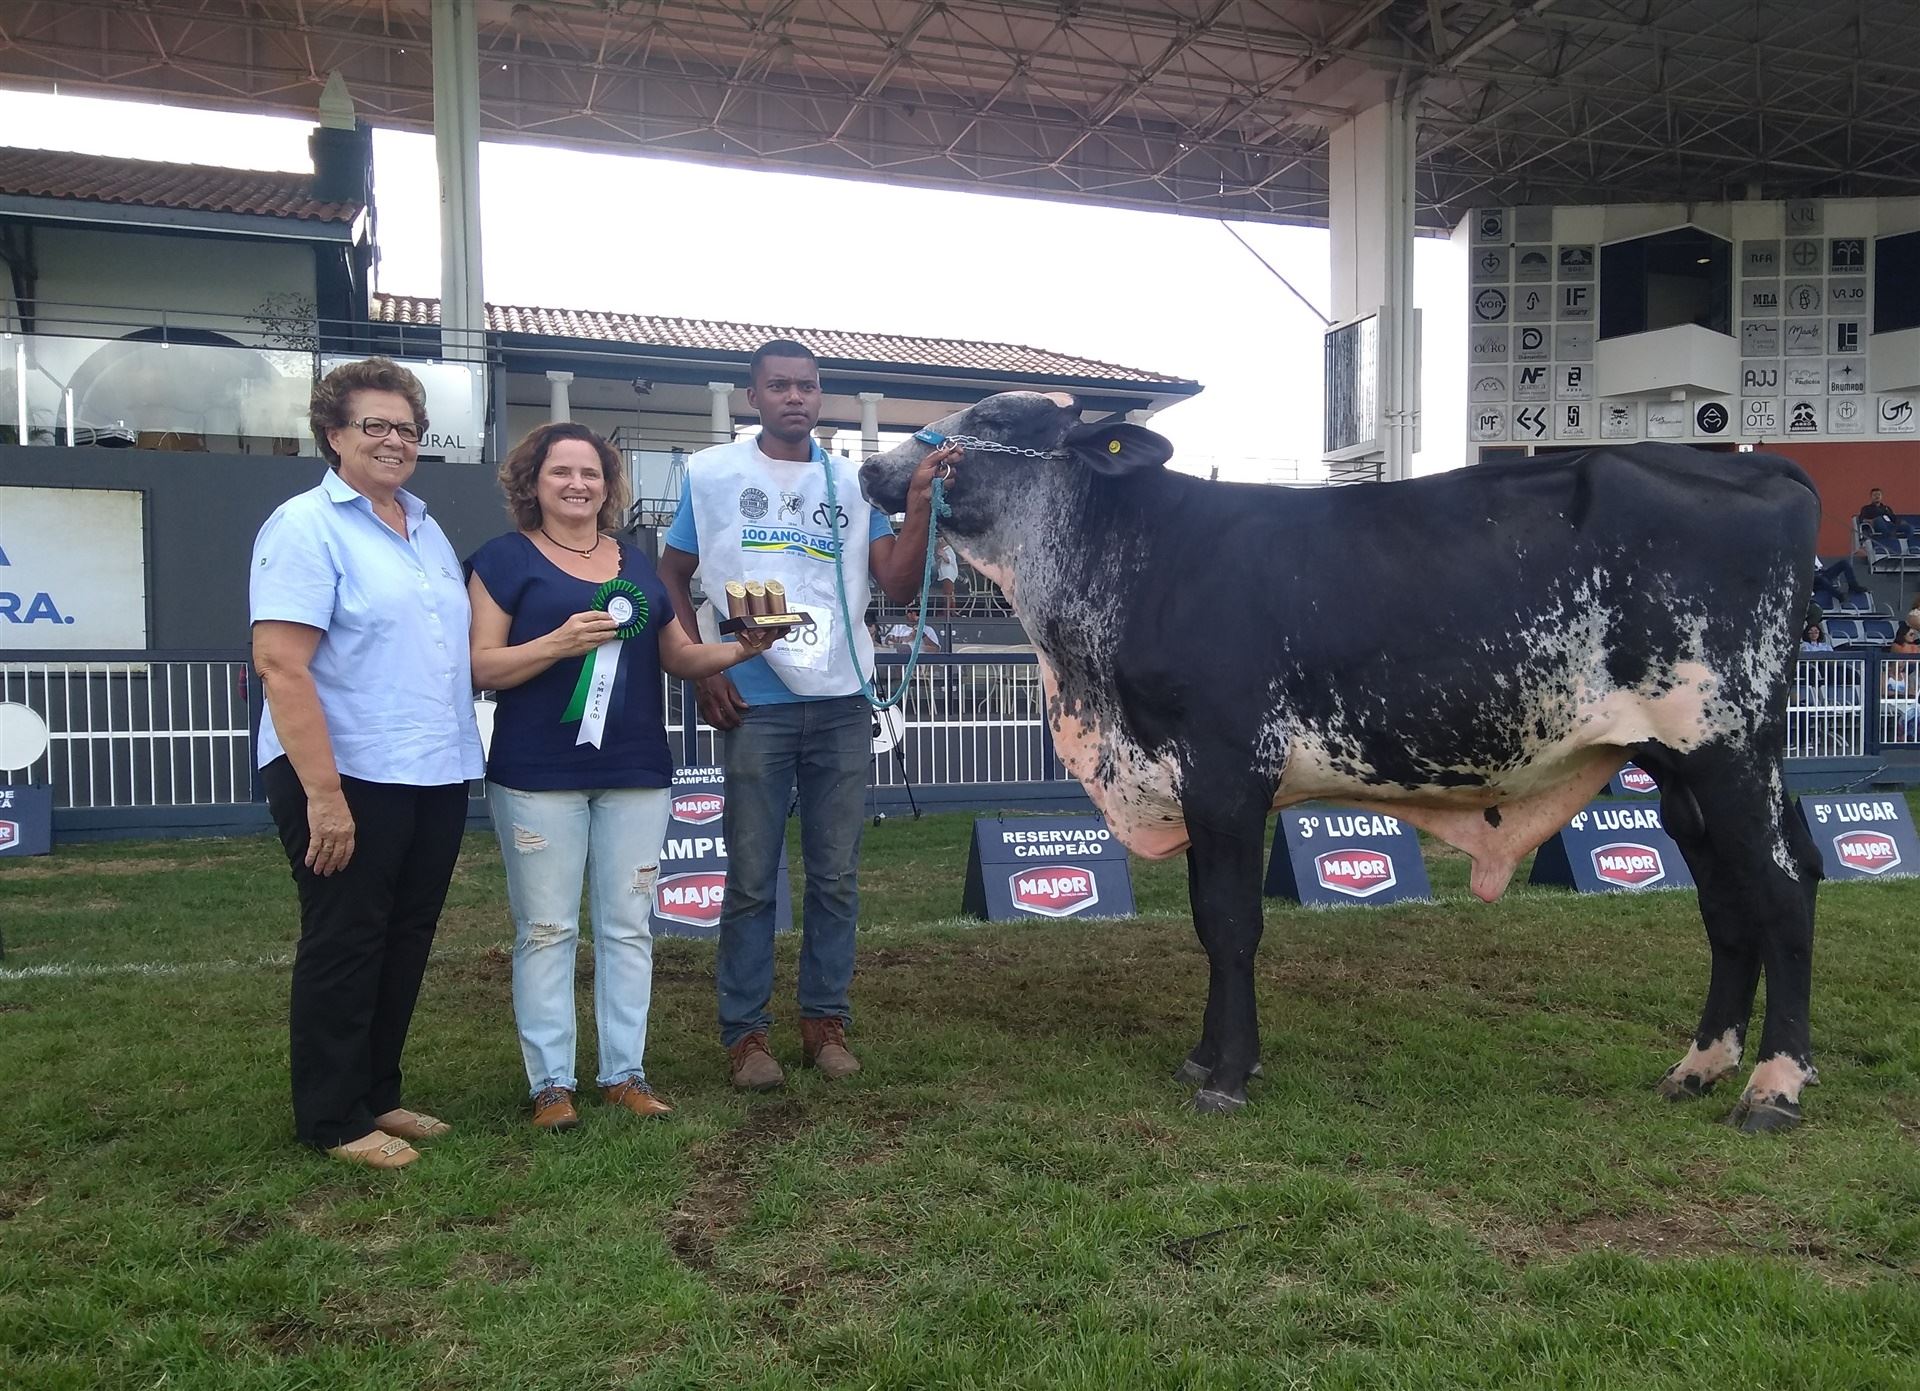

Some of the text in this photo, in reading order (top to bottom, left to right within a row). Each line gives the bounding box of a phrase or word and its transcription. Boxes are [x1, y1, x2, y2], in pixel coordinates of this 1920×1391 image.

[1566, 288, 1587, 306] IF
[1753, 294, 1777, 305] MRA
[1520, 367, 1546, 384] NF
[1745, 370, 1777, 387] AJJ
[1751, 401, 1771, 413] OT
[1746, 415, 1775, 426] OT5
[742, 528, 767, 540] 100
[769, 530, 809, 545] ANOS
[672, 775, 725, 785] CAMPEÃO
[676, 767, 722, 777] GRANDE
[675, 800, 721, 814] MAJOR
[1814, 801, 1898, 823] 5º LUGAR
[1298, 815, 1402, 838] 3º LUGAR
[1592, 809, 1662, 830] LUGAR
[1002, 829, 1110, 843] RESERVADO
[1014, 841, 1102, 857] CAMPEÃO
[1840, 842, 1893, 860] MAJOR
[1323, 860, 1387, 880] MAJOR
[1599, 855, 1656, 874] MAJOR
[1019, 877, 1088, 899] MAJOR
